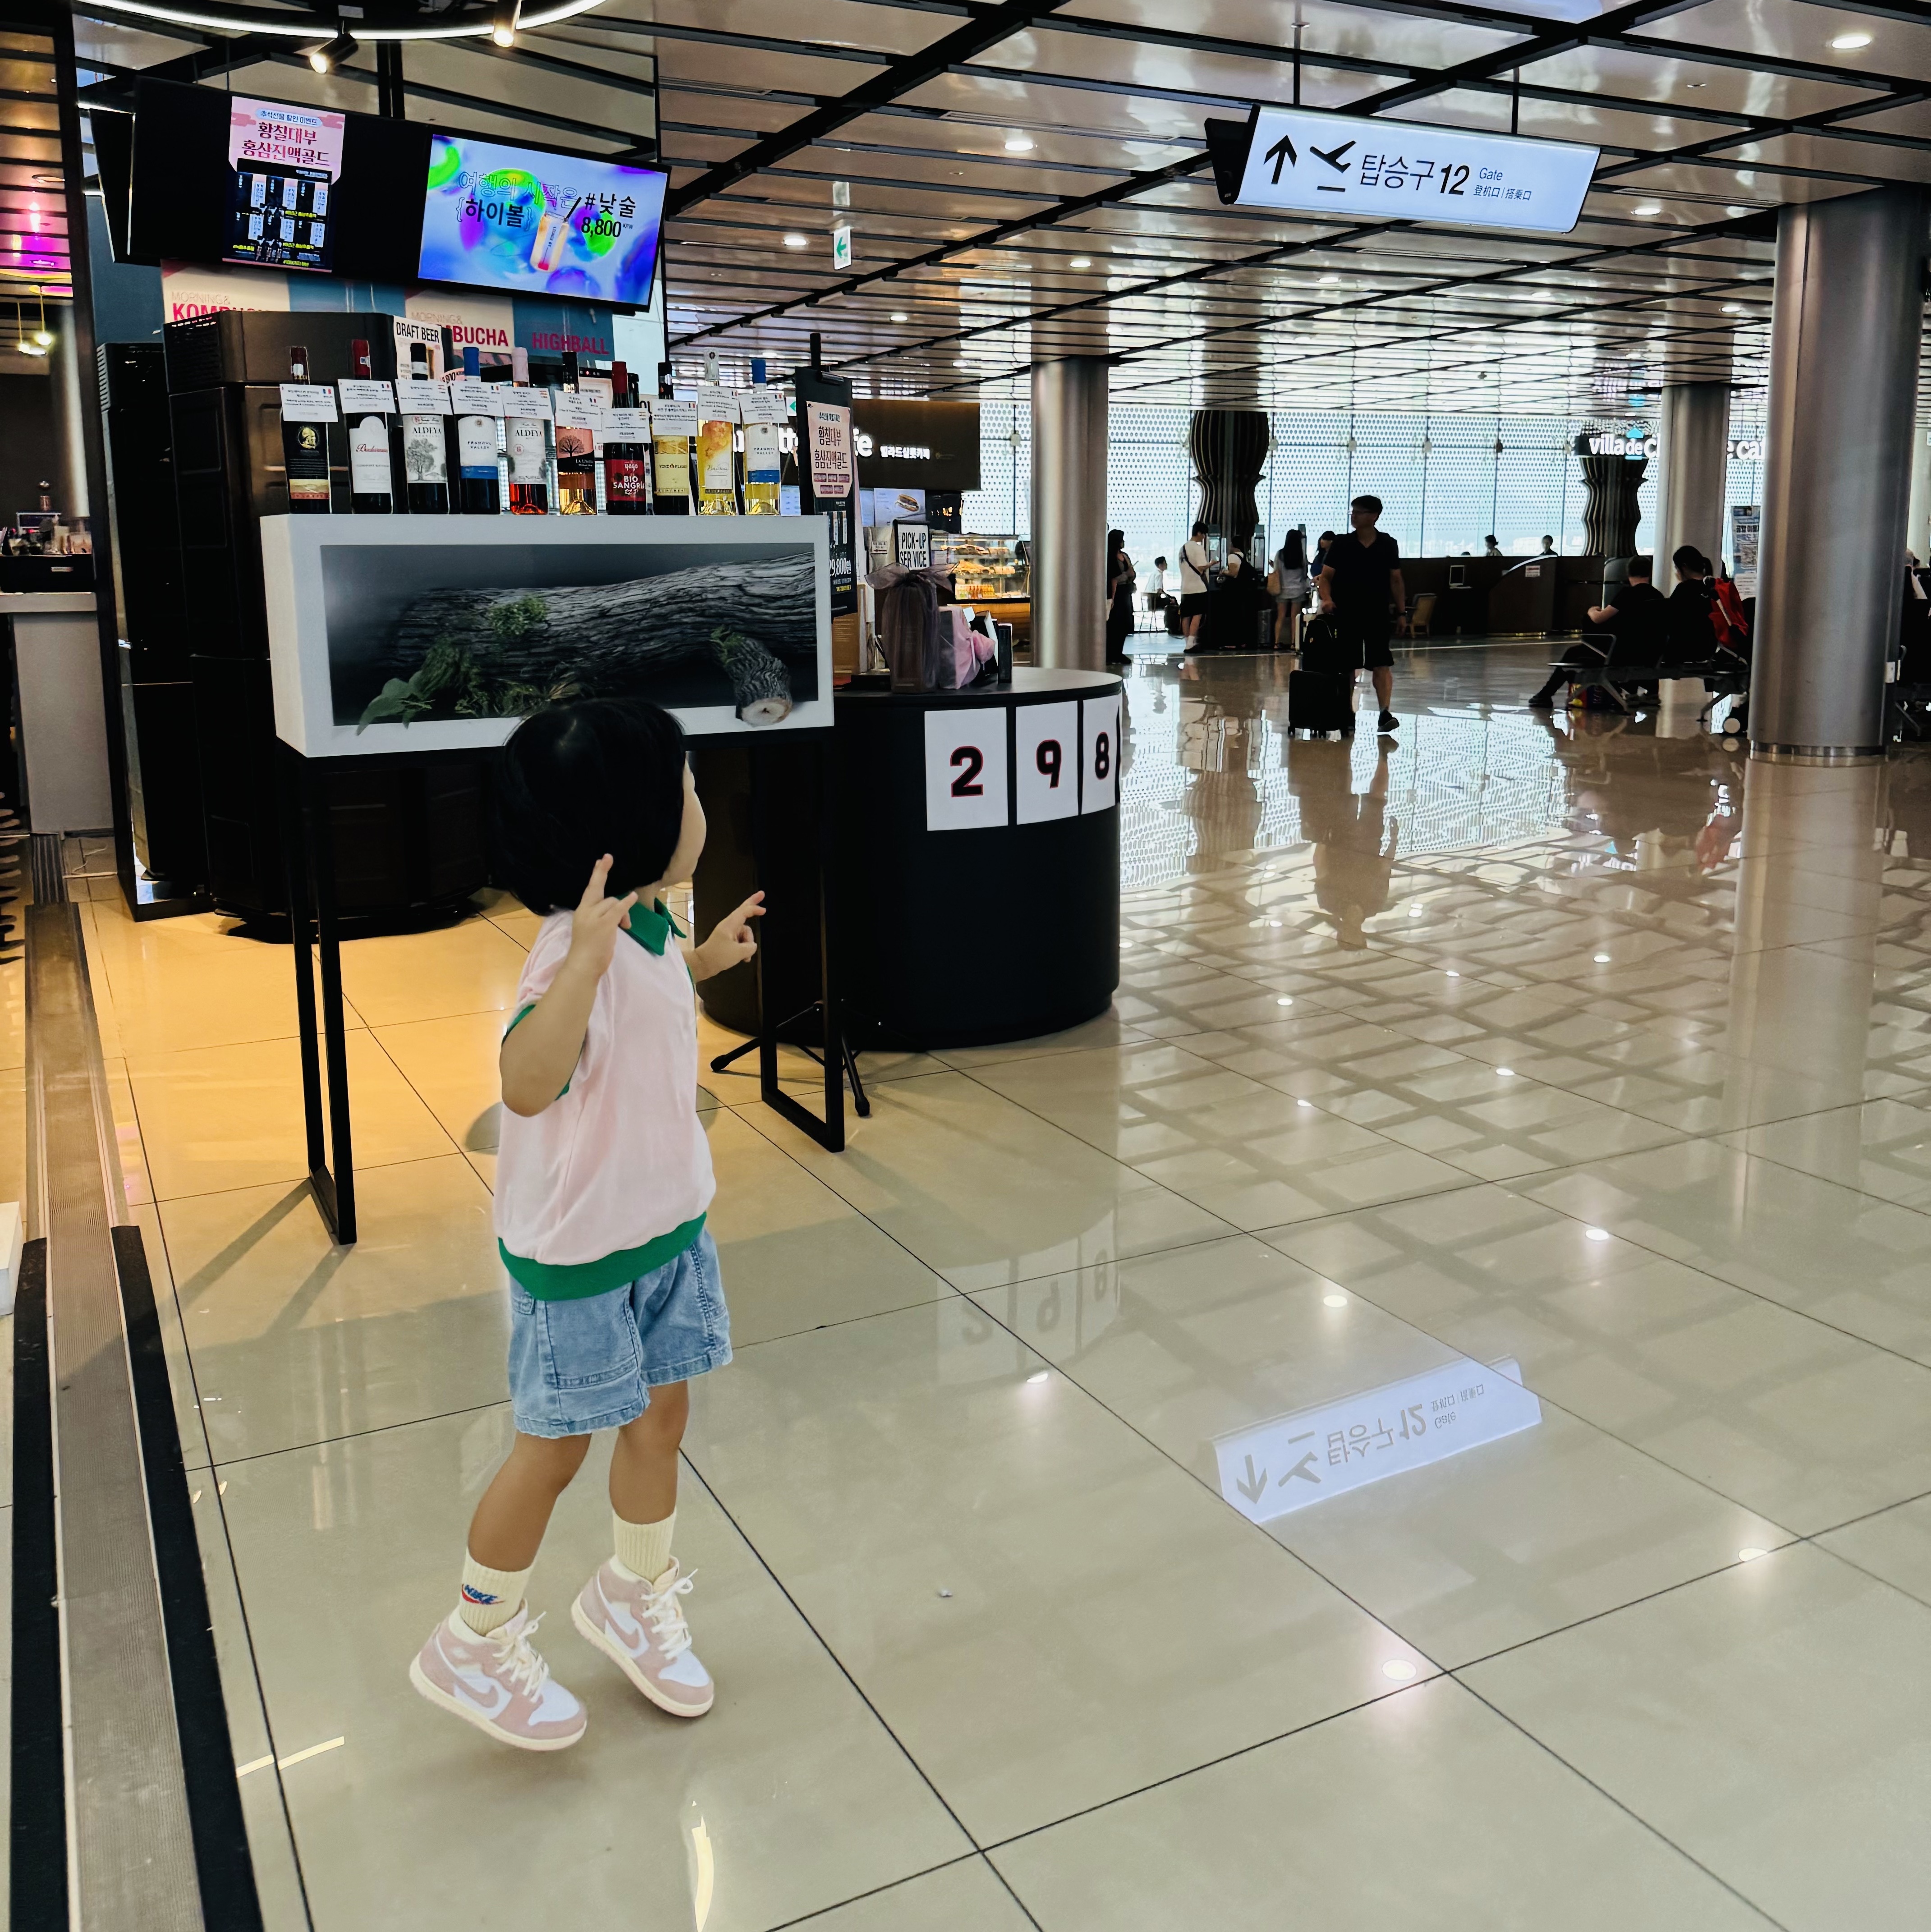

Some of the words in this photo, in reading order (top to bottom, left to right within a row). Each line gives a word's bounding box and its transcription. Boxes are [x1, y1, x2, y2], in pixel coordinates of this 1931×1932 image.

[299, 117, 318, 125] 이벤트
[257, 122, 317, 145] 황칠대부
[242, 139, 330, 166] 홍삼진액골드
[1360, 154, 1435, 191] 탑승구
[1440, 164, 1470, 196] 12
[1479, 167, 1503, 181] Gate
[458, 171, 517, 201] 여행의
[524, 182, 578, 209] 시작은
[580, 216, 622, 238] 8,800
[396, 322, 419, 340] DRAFT
[421, 327, 440, 343] BEER
[532, 332, 610, 355] HIGHBALL
[818, 426, 841, 446] 황칠대부
[1588, 434, 1625, 455] villa
[1626, 438, 1642, 455] de
[1736, 436, 1766, 460] caf
[902, 532, 926, 549] PICK-UP
[950, 745, 984, 798] 2
[1036, 739, 1062, 789] 9
[1095, 732, 1110, 780] 8
